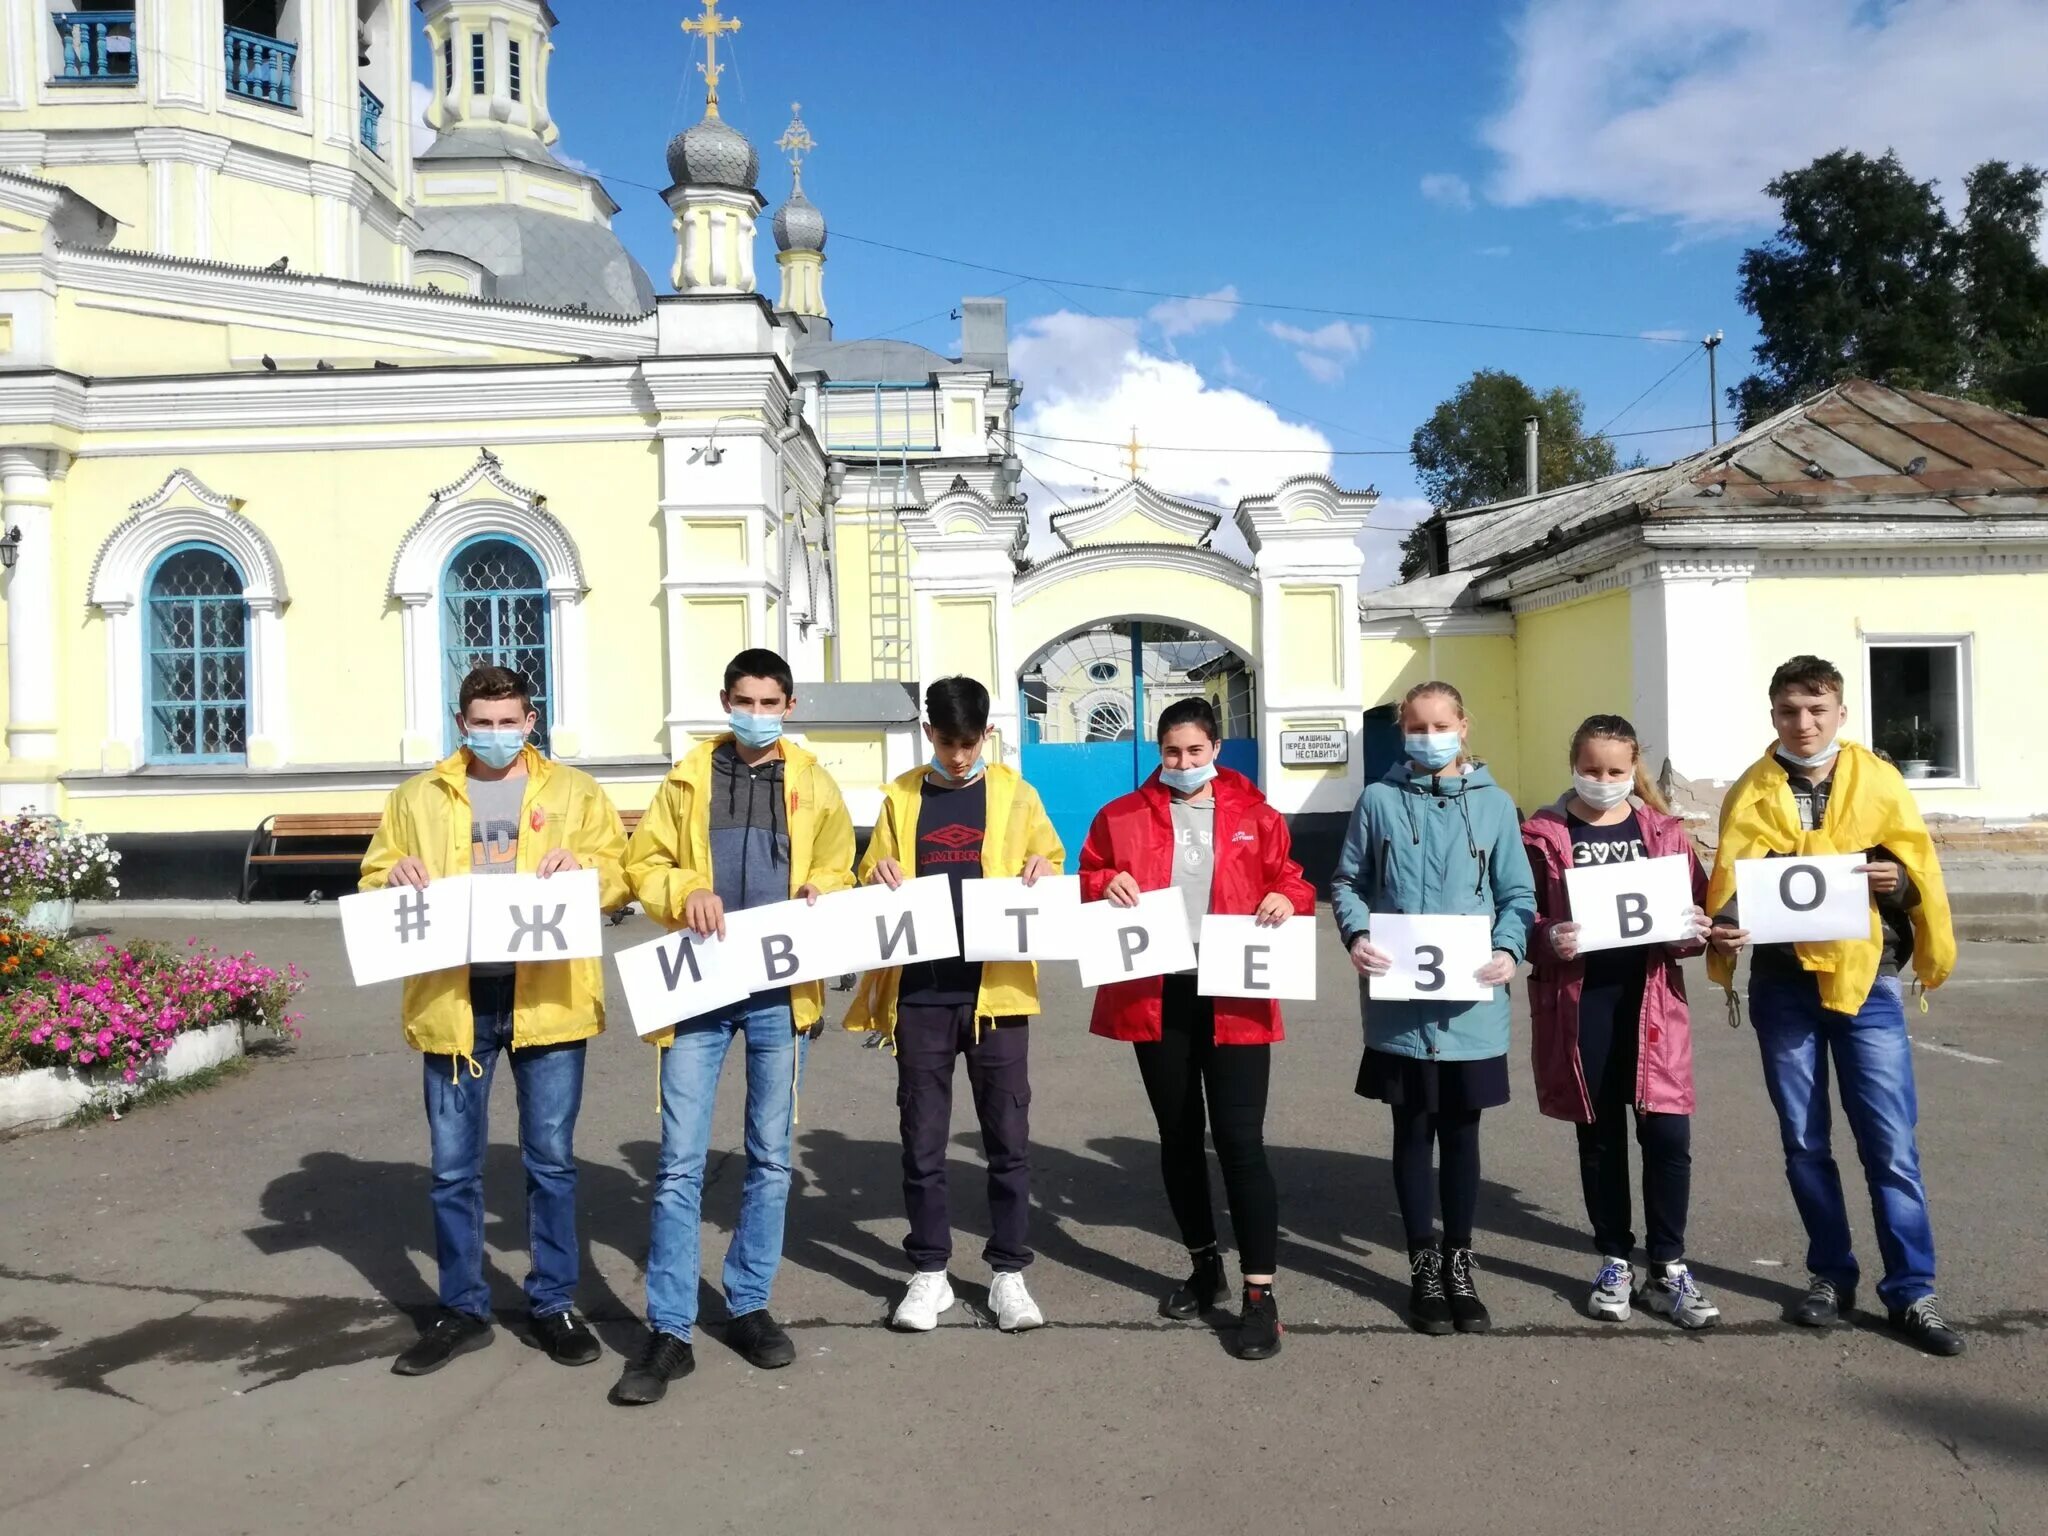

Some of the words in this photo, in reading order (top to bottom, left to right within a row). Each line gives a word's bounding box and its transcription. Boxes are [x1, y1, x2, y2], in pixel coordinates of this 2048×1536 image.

[1285, 742, 1307, 750] ПЕРЕД
[1307, 742, 1341, 750] ВОРОТАМИ
[1298, 734, 1332, 742] МАШИНЫ
[1778, 864, 1828, 912] О
[395, 891, 430, 943] #
[507, 904, 568, 952] Ж
[875, 910, 918, 961] И
[1004, 907, 1039, 954] Т
[1615, 892, 1654, 939] В
[655, 936, 702, 992] И
[760, 934, 800, 982] В
[1117, 925, 1150, 973] Р
[1243, 944, 1271, 991] Е
[1414, 944, 1446, 992] З
